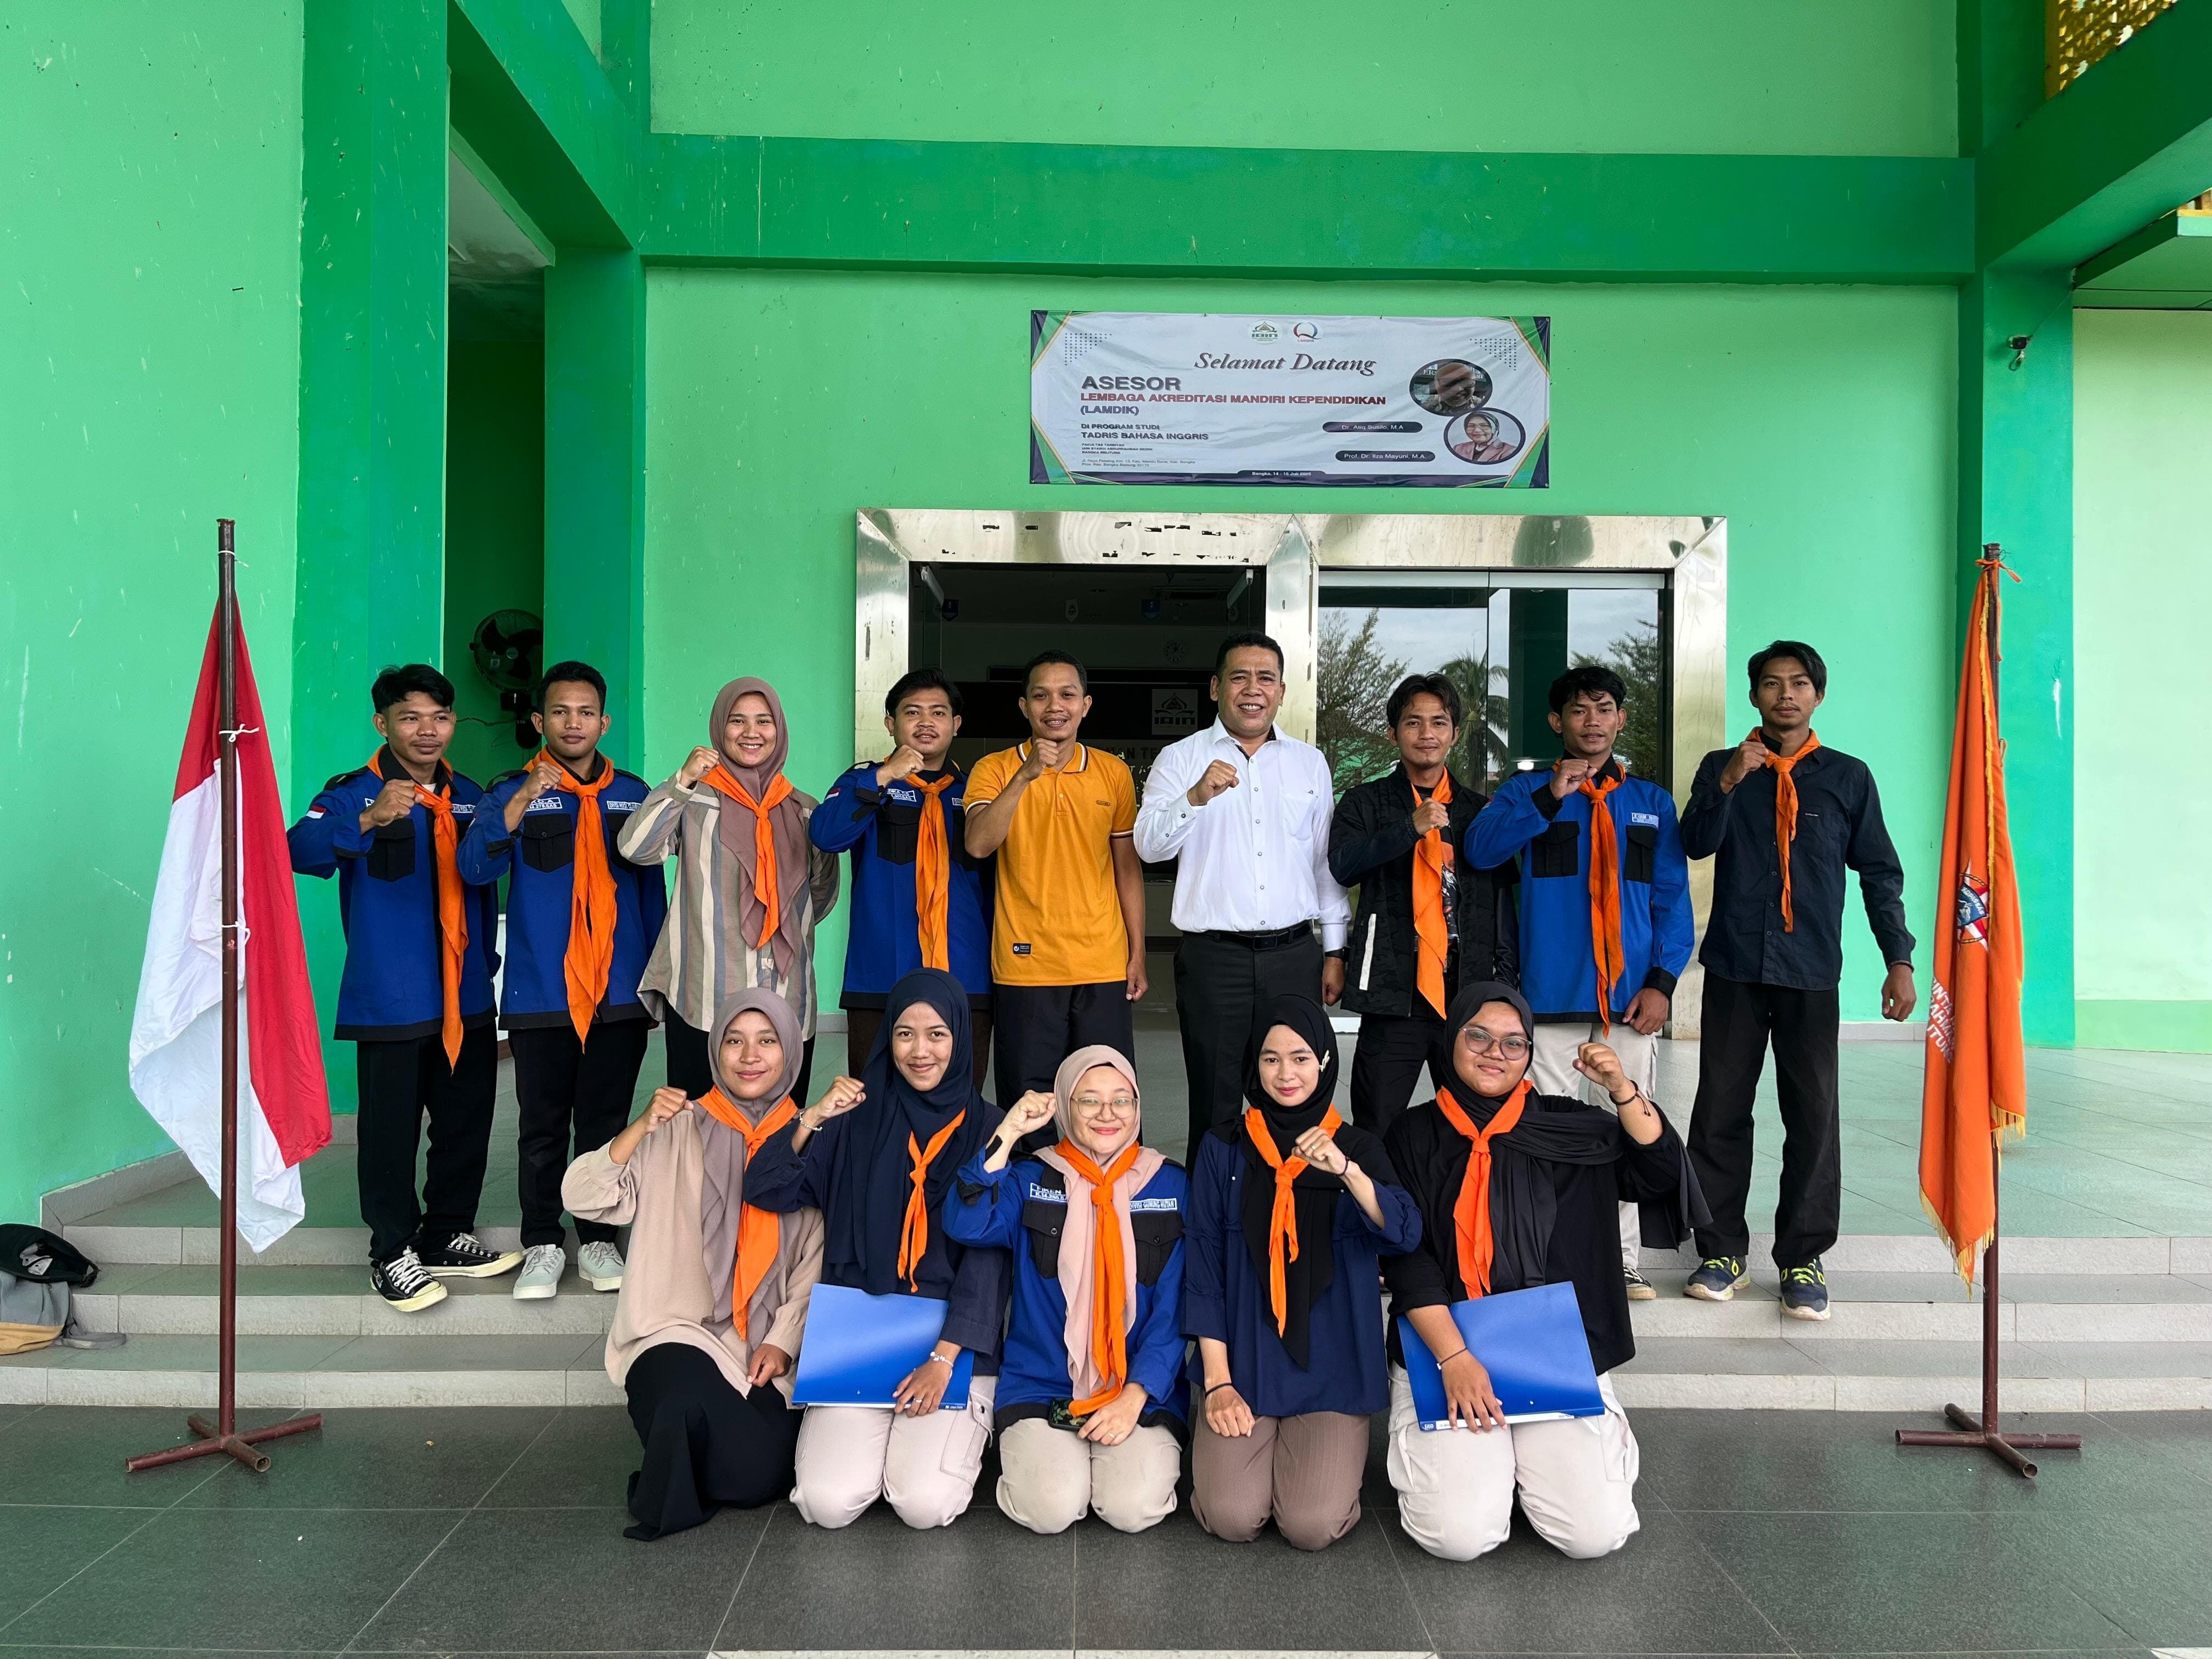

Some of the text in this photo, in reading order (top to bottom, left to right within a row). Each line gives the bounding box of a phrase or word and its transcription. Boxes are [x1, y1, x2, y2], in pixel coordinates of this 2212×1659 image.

[1194, 352, 1376, 376] Selamat Datang
[1081, 376, 1182, 391] ASESOR
[1081, 393, 1386, 405] LEMBAGA AKREDITASI MANDIRI KEPENDIDIKAN
[1080, 405, 1139, 416] (LAMDIK)
[1143, 1200, 1160, 1208] GUNUNG
[1160, 1200, 1174, 1208] HUTAN
